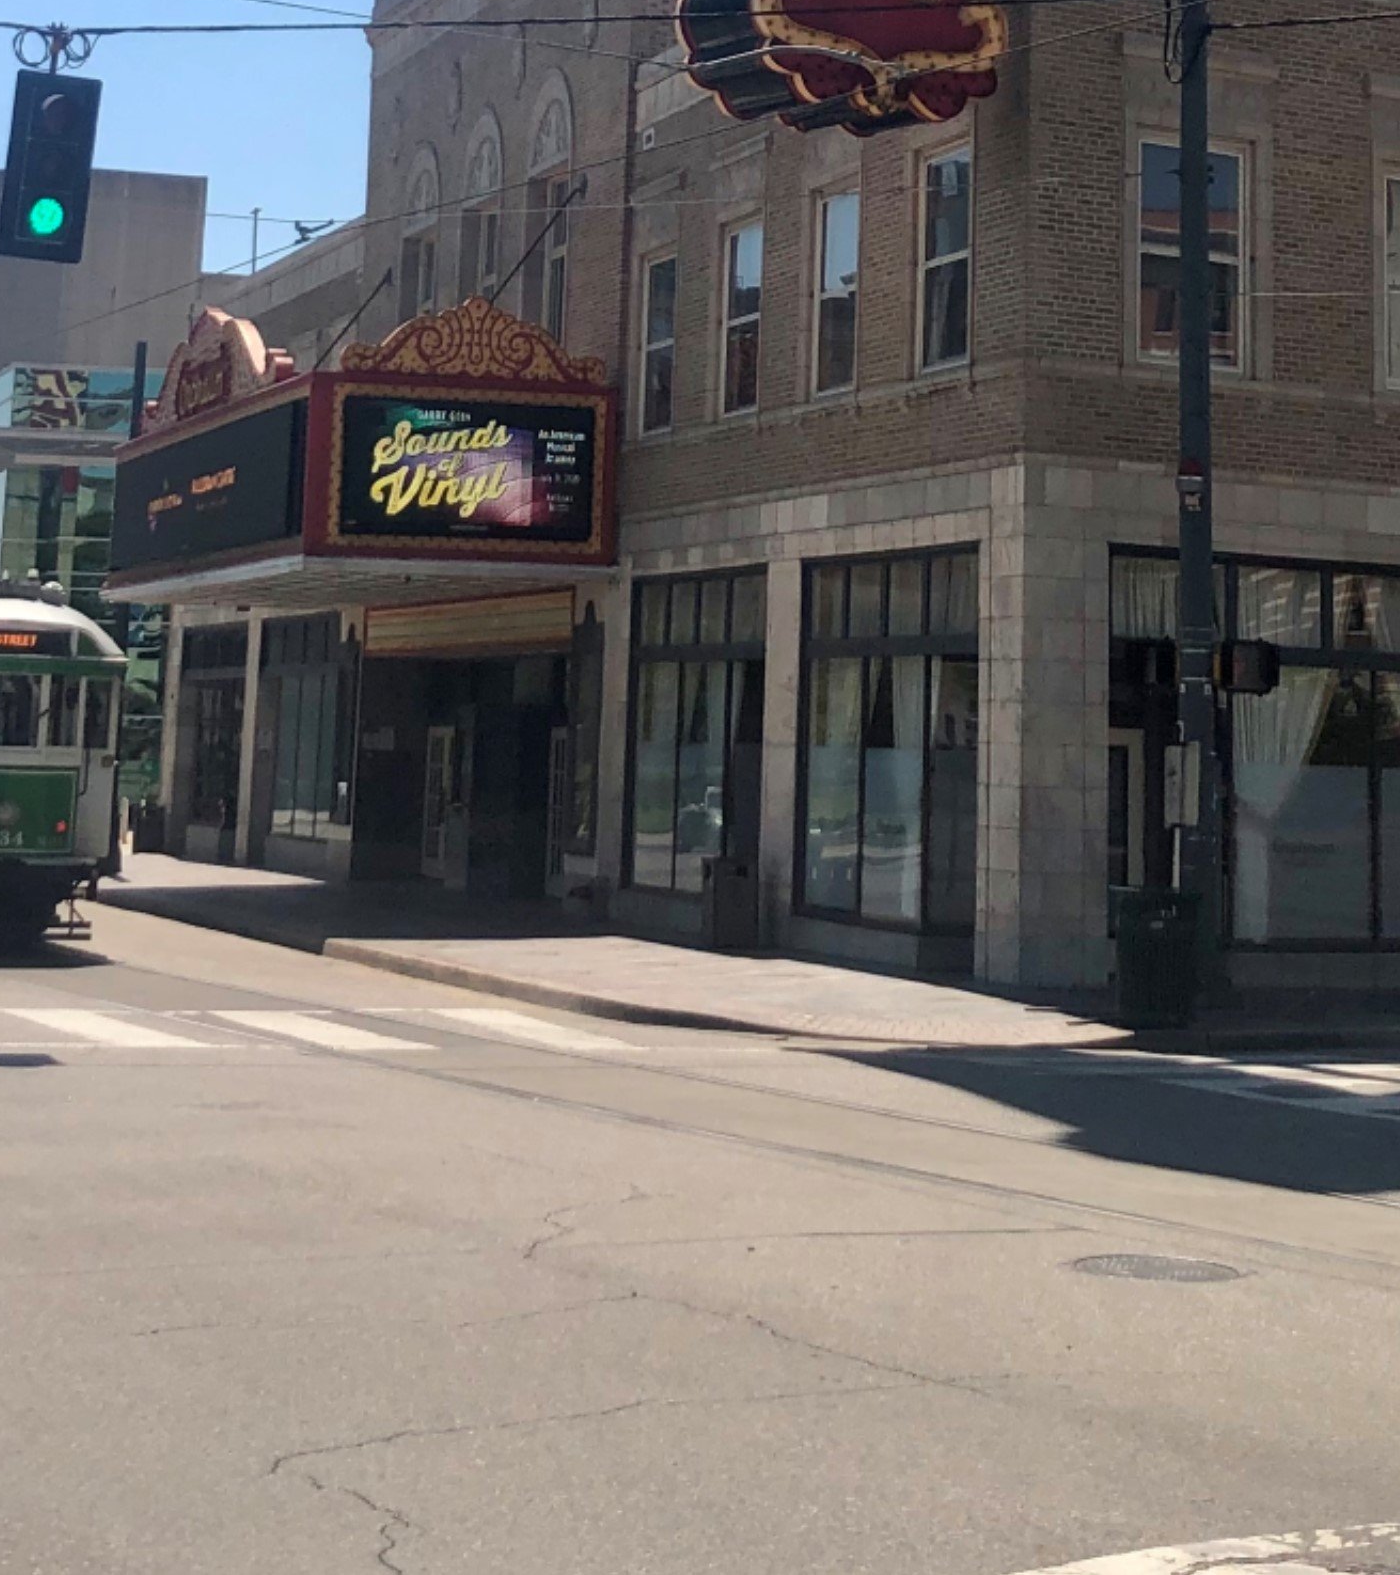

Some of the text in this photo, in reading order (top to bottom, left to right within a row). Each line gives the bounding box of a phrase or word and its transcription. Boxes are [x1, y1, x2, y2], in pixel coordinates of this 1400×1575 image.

[371, 420, 513, 474] Sounds
[437, 453, 464, 477] of
[369, 461, 508, 518] Vinyl
